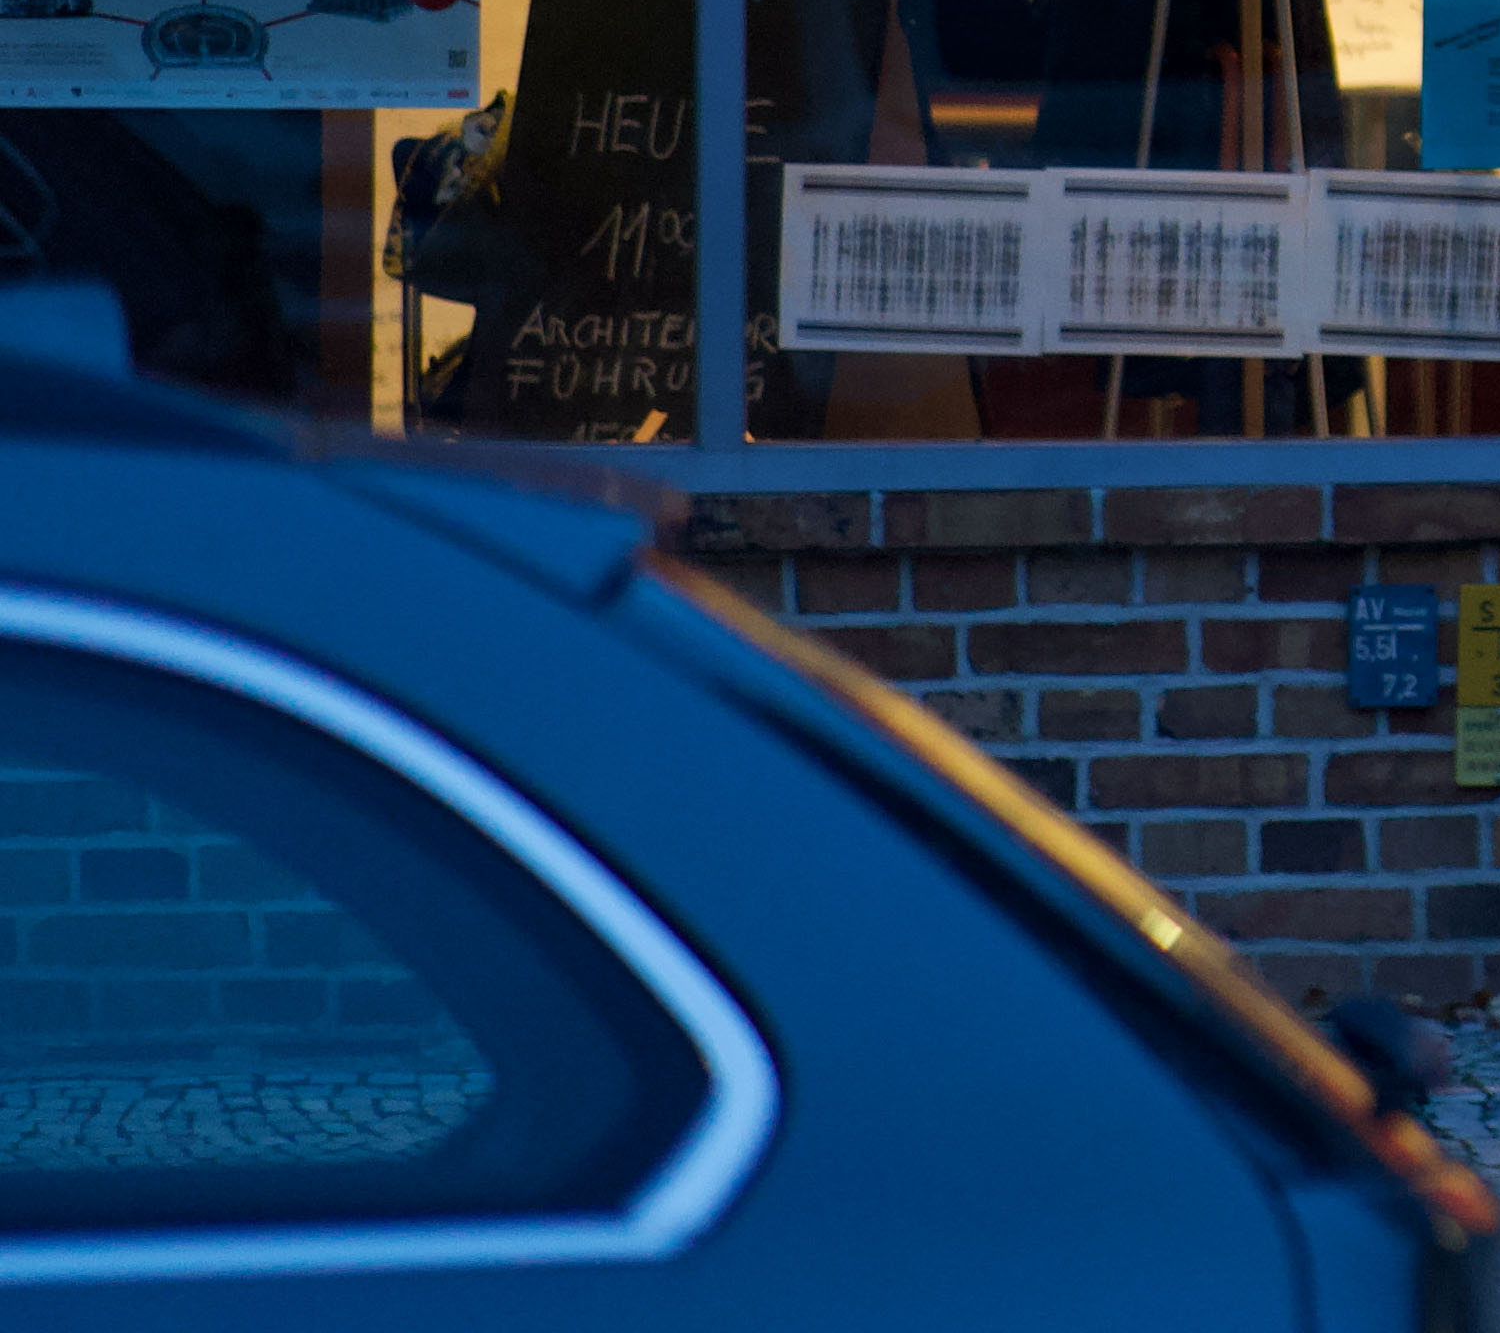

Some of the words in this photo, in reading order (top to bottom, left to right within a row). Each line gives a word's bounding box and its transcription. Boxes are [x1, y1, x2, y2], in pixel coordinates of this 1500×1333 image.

[569, 90, 782, 162] HEUE
[1355, 597, 1386, 621] AV
[1478, 600, 1495, 623] S
[1381, 672, 1419, 700] 7,2
